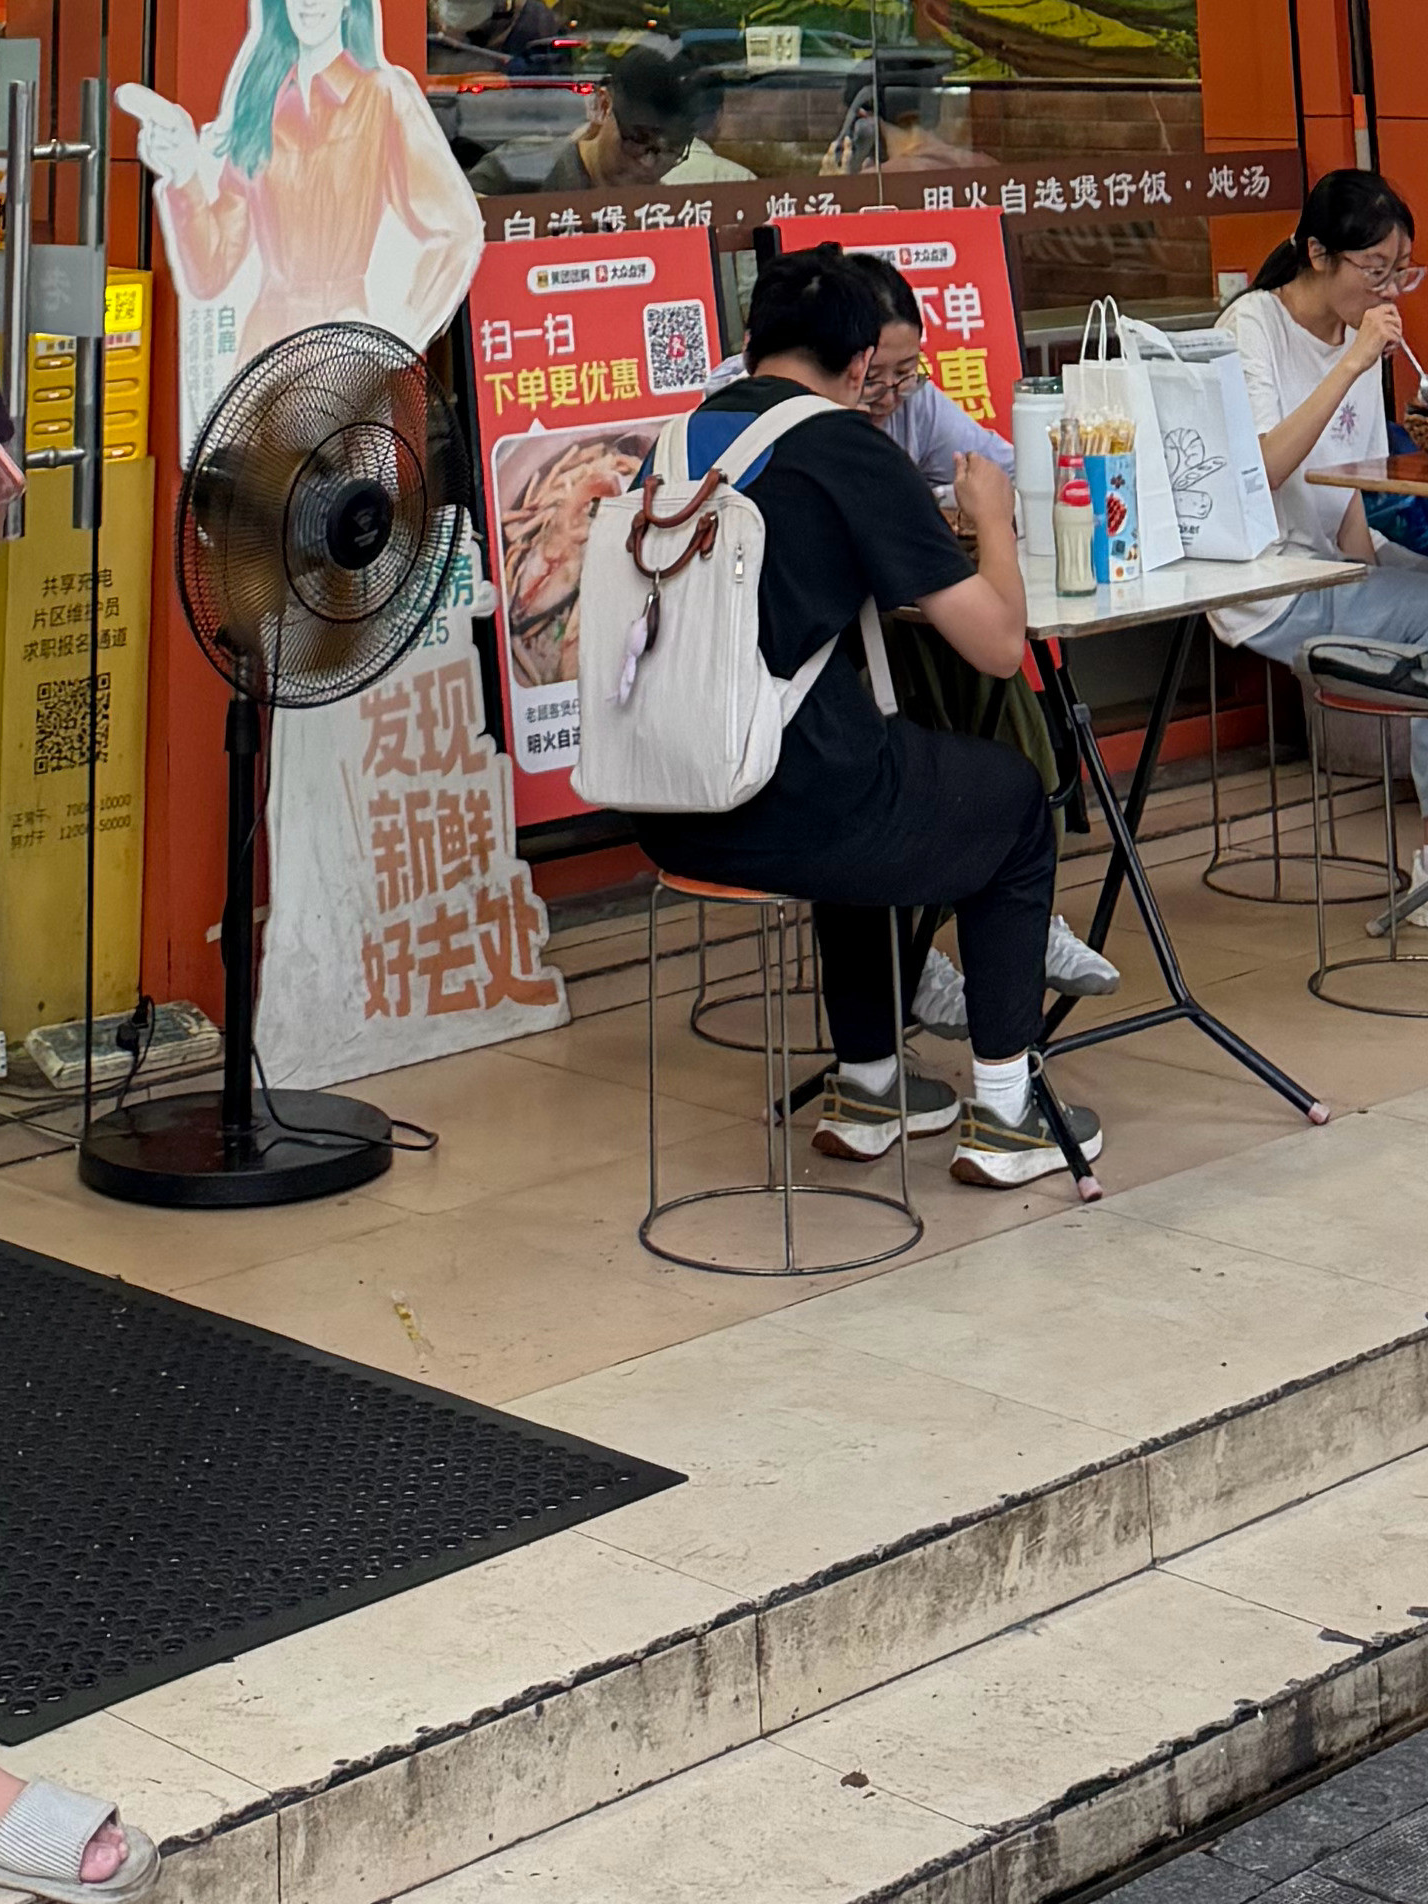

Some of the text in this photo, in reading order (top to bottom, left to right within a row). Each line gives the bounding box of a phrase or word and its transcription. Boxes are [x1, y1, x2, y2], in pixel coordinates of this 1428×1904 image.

[480, 312, 576, 363] 扫一扫
[483, 357, 642, 417] 下单更优惠
[359, 657, 488, 778] 发现
[371, 789, 496, 914] 新鲜
[362, 874, 560, 1020] 好去处
